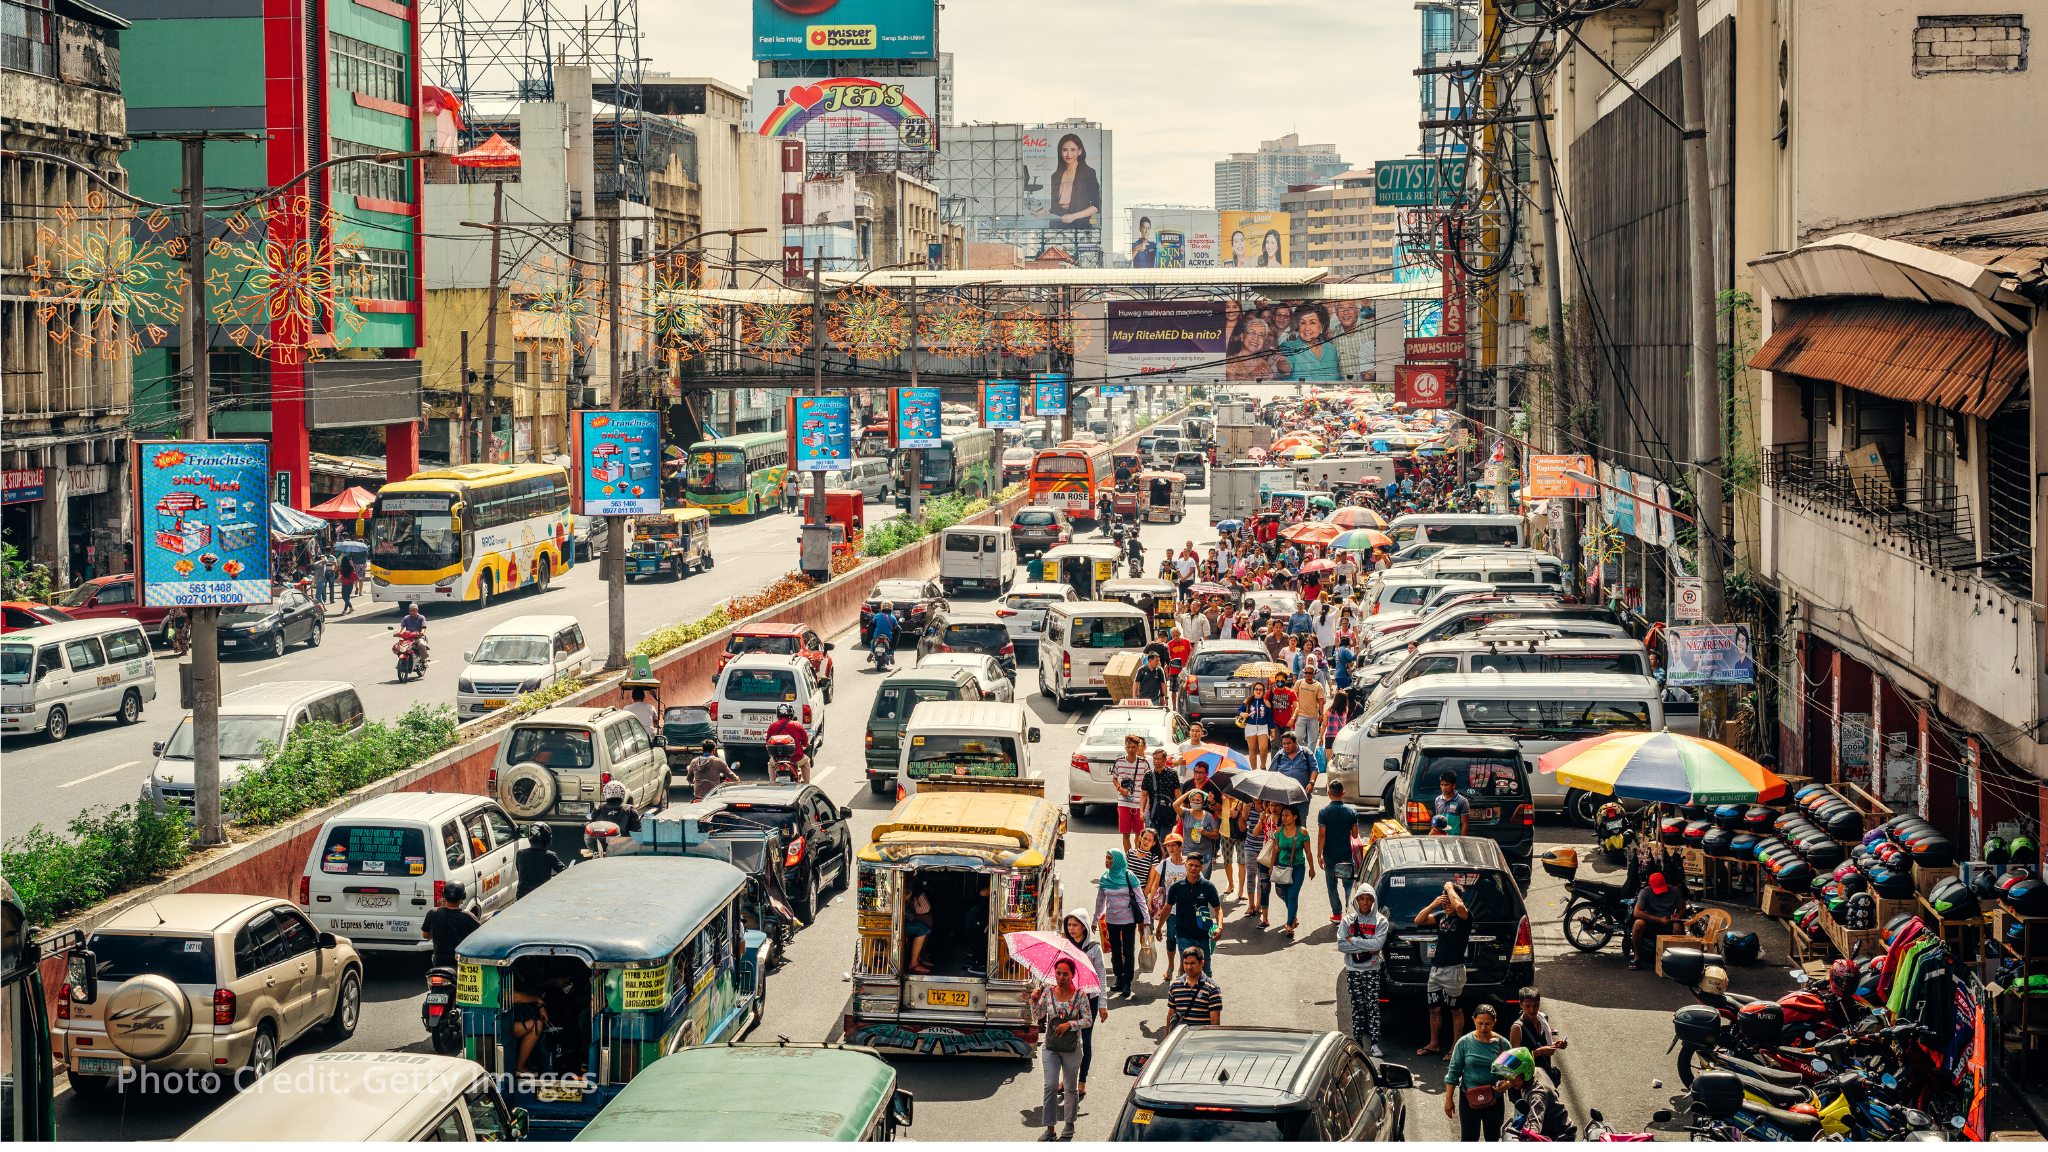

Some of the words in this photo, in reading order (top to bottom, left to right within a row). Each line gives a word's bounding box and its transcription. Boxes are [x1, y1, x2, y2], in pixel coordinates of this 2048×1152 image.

[828, 37, 871, 46] Donut
[777, 90, 785, 106] I
[824, 84, 904, 112] JED'S
[905, 125, 927, 138] 24
[1380, 192, 1405, 201] HOTEL
[1406, 192, 1412, 200] &
[1162, 247, 1179, 257] SUN
[1160, 258, 1182, 268] RAIN
[1118, 309, 1141, 317] Huwag
[1112, 330, 1135, 342] May
[1136, 330, 1179, 340] RiteMED
[1181, 330, 1194, 340] ba
[1196, 330, 1221, 340] nito?
[1407, 342, 1465, 354] PAWNSHOP
[602, 429, 627, 439] SNOW
[624, 435, 642, 443] MAN
[158, 451, 180, 465] New!
[189, 455, 252, 466] Franchise
[9, 471, 21, 488] STOP
[23, 470, 43, 487] BICYCLE
[172, 470, 215, 485] SNOW
[209, 480, 240, 491] MAN
[189, 584, 206, 593] 563
[209, 583, 231, 593] 1408
[176, 595, 198, 604] 0927
[201, 594, 216, 603] 011
[220, 594, 243, 603] 8000
[1686, 640, 1731, 650] NAZARENO
[1709, 794, 1748, 802] MICROMATIC
[960, 827, 997, 835] SPURS
[331, 919, 339, 928] UV
[341, 919, 362, 931] Express
[363, 920, 384, 930] Service
[643, 971, 654, 979] 24/7
[932, 992, 945, 1000] TWZ
[952, 993, 965, 1002] 122
[853, 1024, 1033, 1057] ARTHUR
